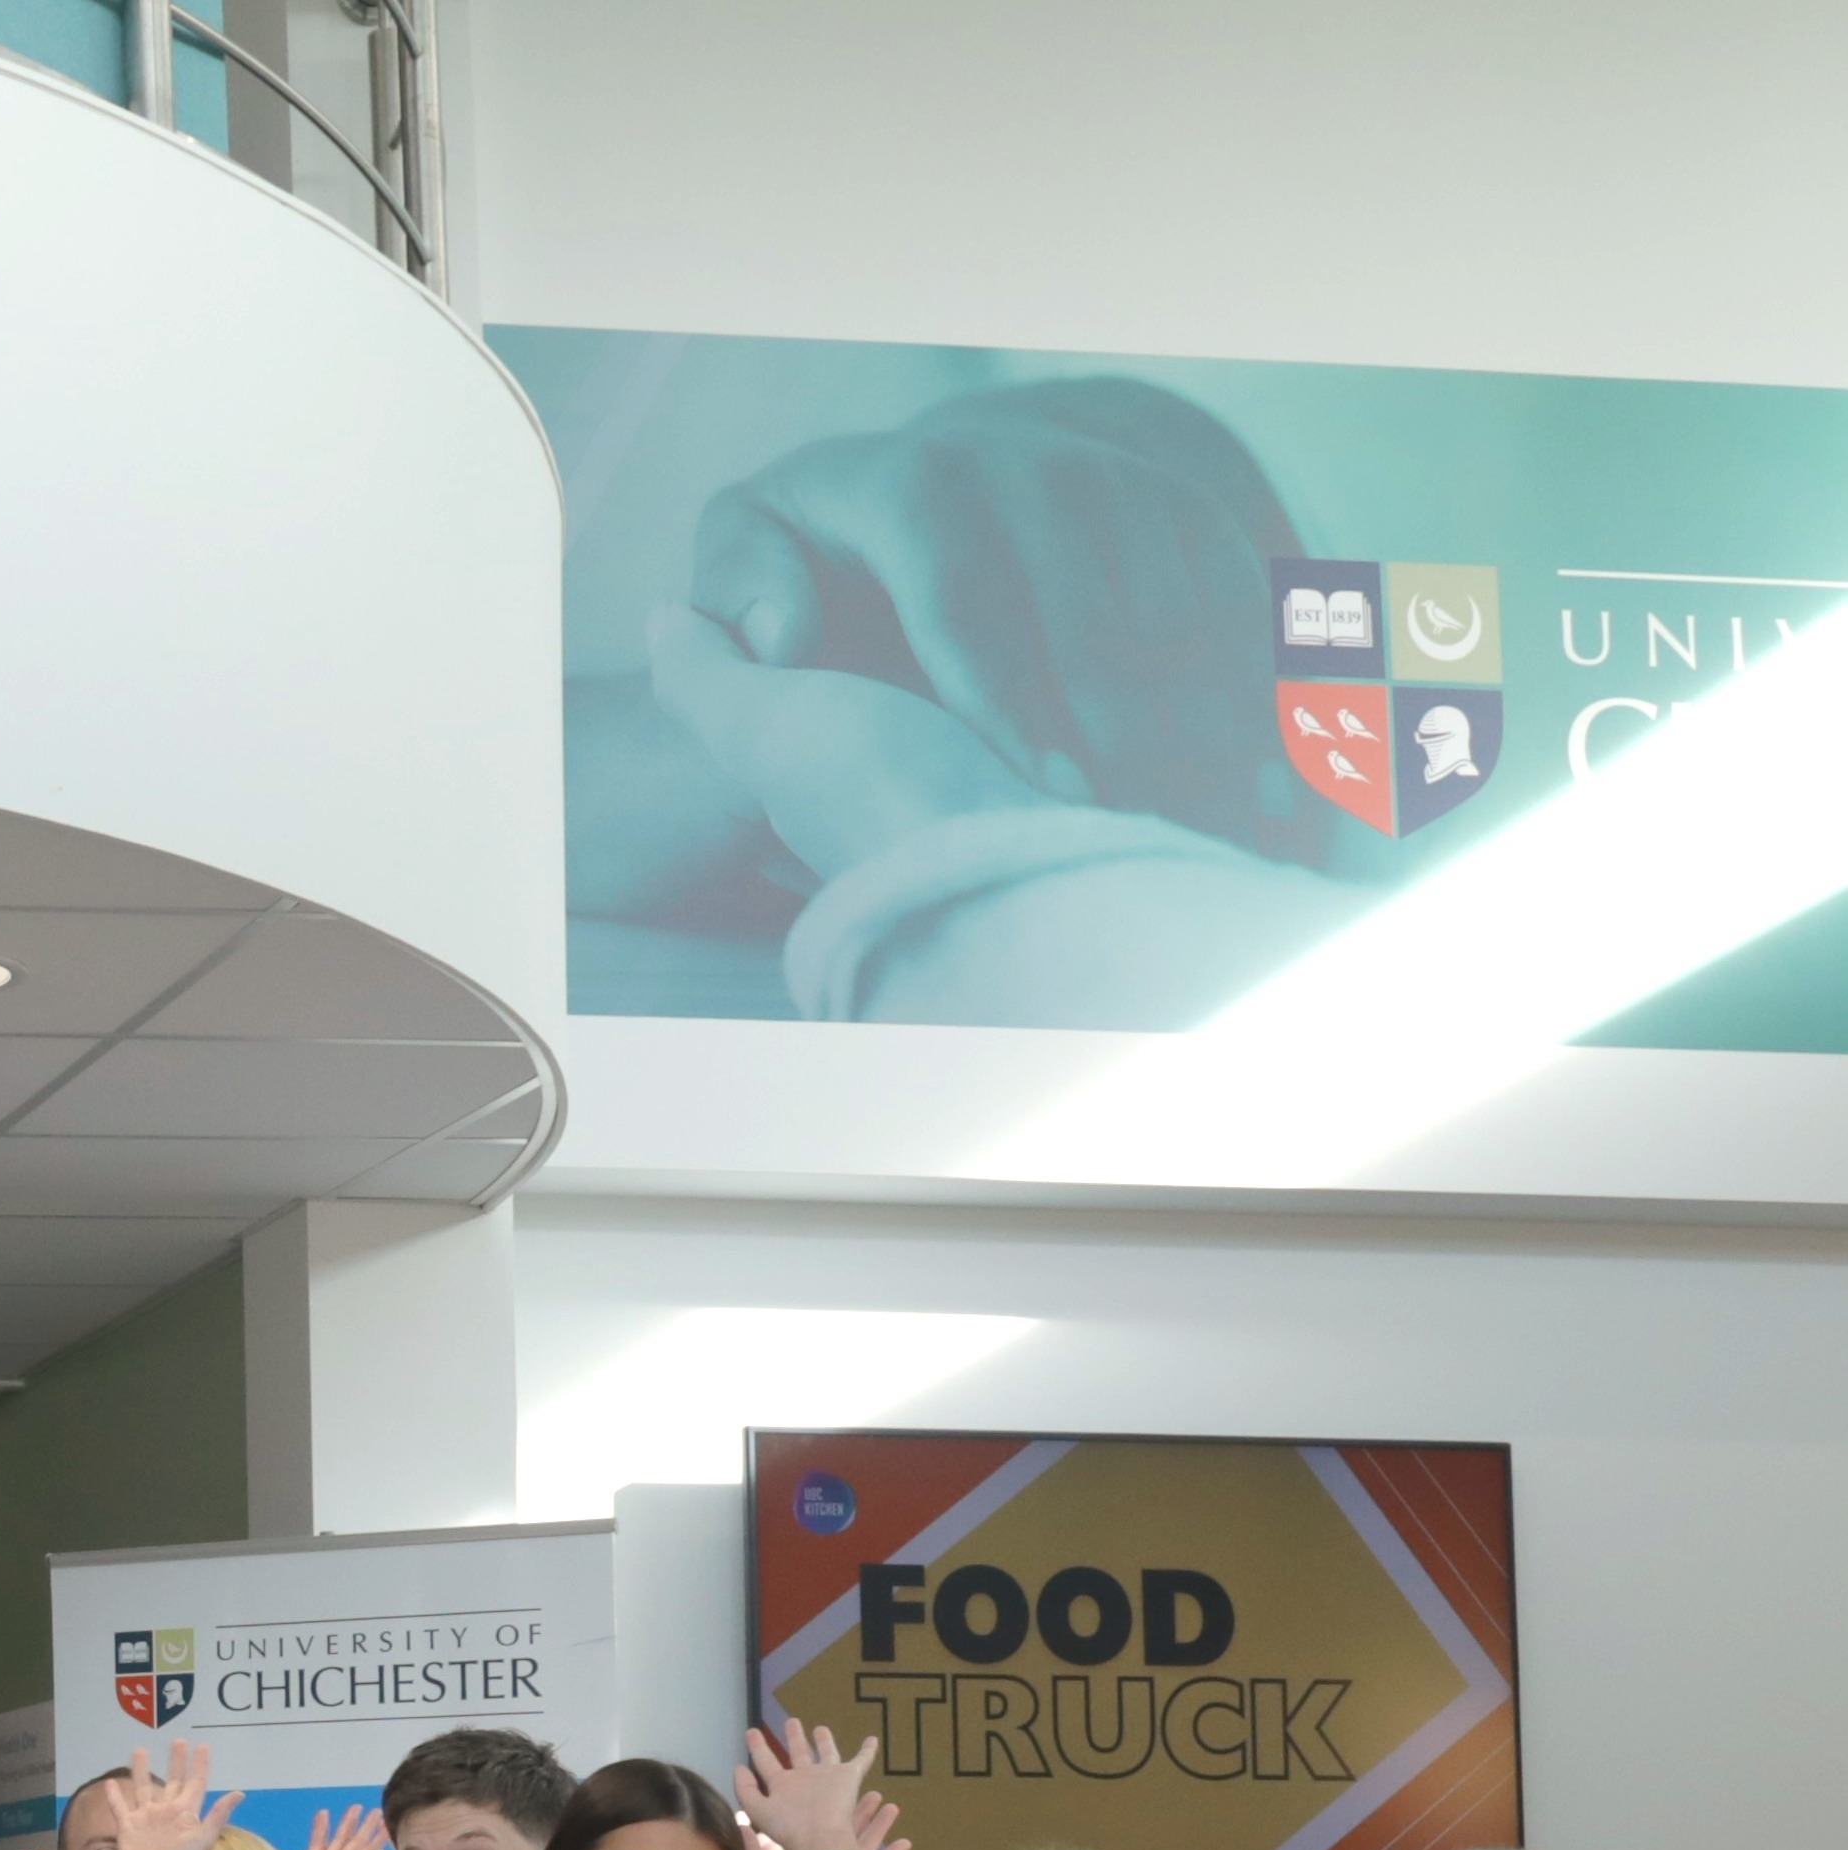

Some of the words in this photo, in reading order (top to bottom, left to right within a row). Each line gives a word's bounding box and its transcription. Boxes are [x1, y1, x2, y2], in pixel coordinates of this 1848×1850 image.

[1294, 608, 1322, 623] EST
[1331, 608, 1362, 625] 1839
[804, 1502, 844, 1516] KITCHEN
[858, 1562, 1235, 1668] FOOD
[216, 1627, 468, 1661] UNIVERSITY
[495, 1623, 543, 1647] OF
[217, 1657, 543, 1712] CHICHESTER
[854, 1672, 1358, 1783] TRUCK
